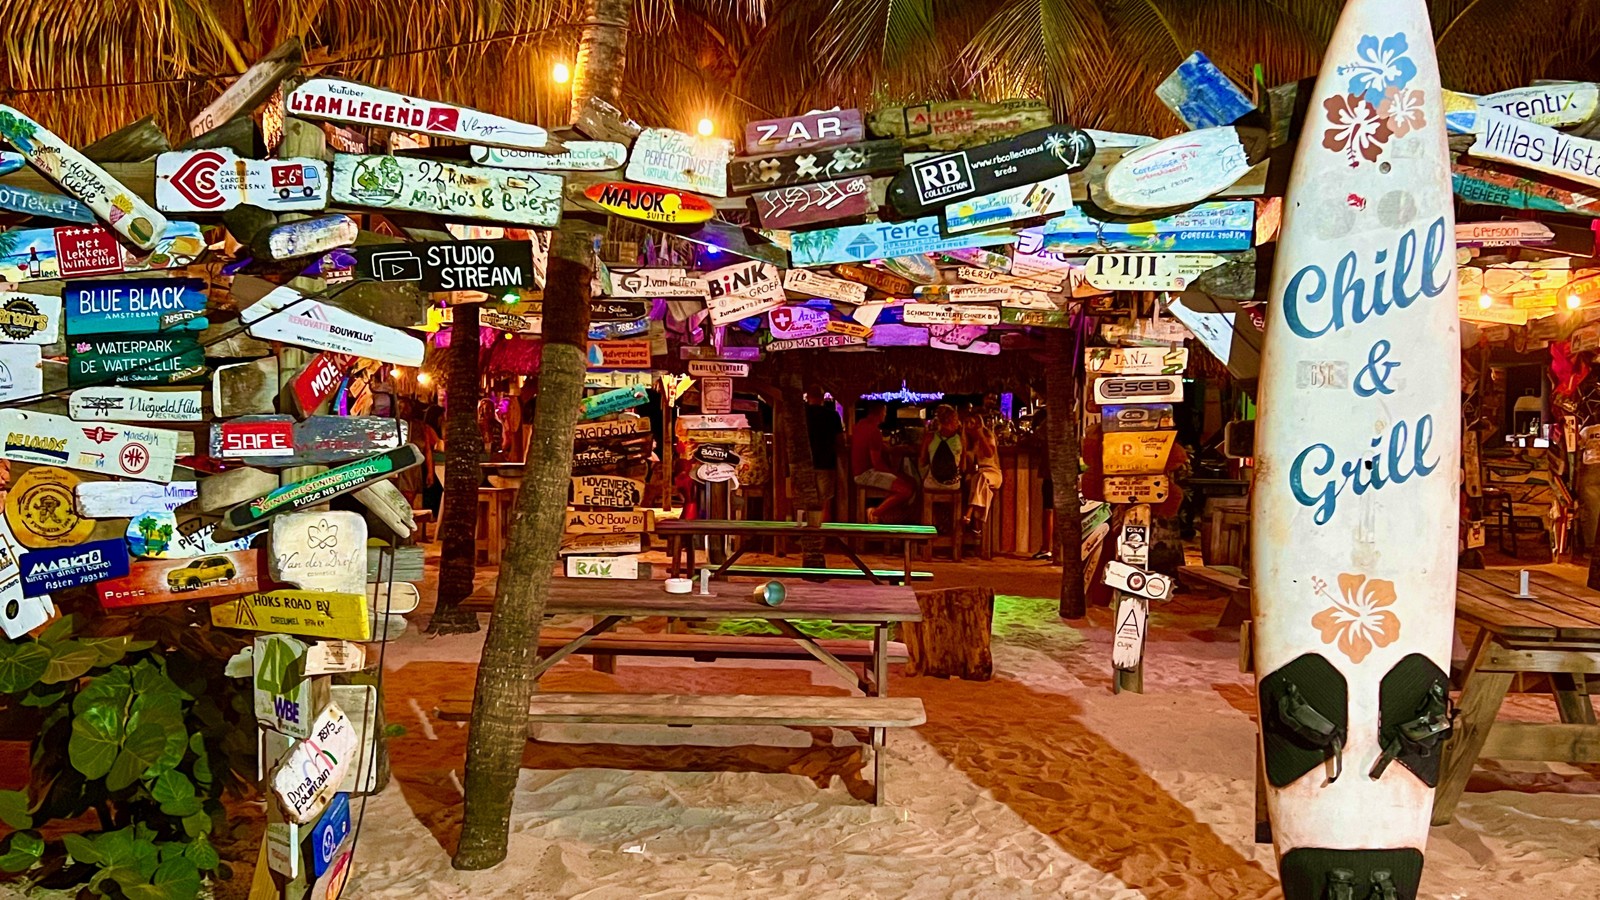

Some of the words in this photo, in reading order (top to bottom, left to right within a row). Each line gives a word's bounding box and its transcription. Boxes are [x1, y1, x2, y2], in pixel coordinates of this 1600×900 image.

[328, 84, 364, 97] YouTuber
[291, 92, 343, 115] LIAM
[349, 101, 425, 127] LEGEND
[756, 117, 842, 146] ZAR
[1485, 119, 1545, 163] Villas
[919, 159, 961, 191] RB
[994, 166, 1018, 178] Breda
[923, 180, 968, 199] COLLECTION
[600, 187, 665, 213] MAJOR
[646, 211, 676, 222] SUITES
[77, 239, 99, 248] Het
[66, 249, 109, 259] Lekkere
[427, 246, 494, 266] STUDIO
[441, 266, 522, 288] STREAM
[708, 262, 768, 298] BiNK
[1283, 216, 1451, 339] Chill
[749, 280, 779, 297] GROEP
[79, 289, 122, 314] BLUE
[129, 287, 186, 310] BLACK
[105, 311, 159, 320] AMSTERDAM
[96, 340, 173, 354] WATERPARK
[797, 336, 840, 347] MASTERS
[80, 360, 97, 374] DE
[1353, 339, 1402, 397] &
[227, 433, 288, 449] SAFE
[1289, 414, 1440, 525] Grill
[45, 579, 73, 590] Asten
[254, 594, 280, 609] HOKS
[284, 599, 312, 611] ROAD
[286, 776, 313, 804] Dyna
[293, 767, 331, 816] Fountain
